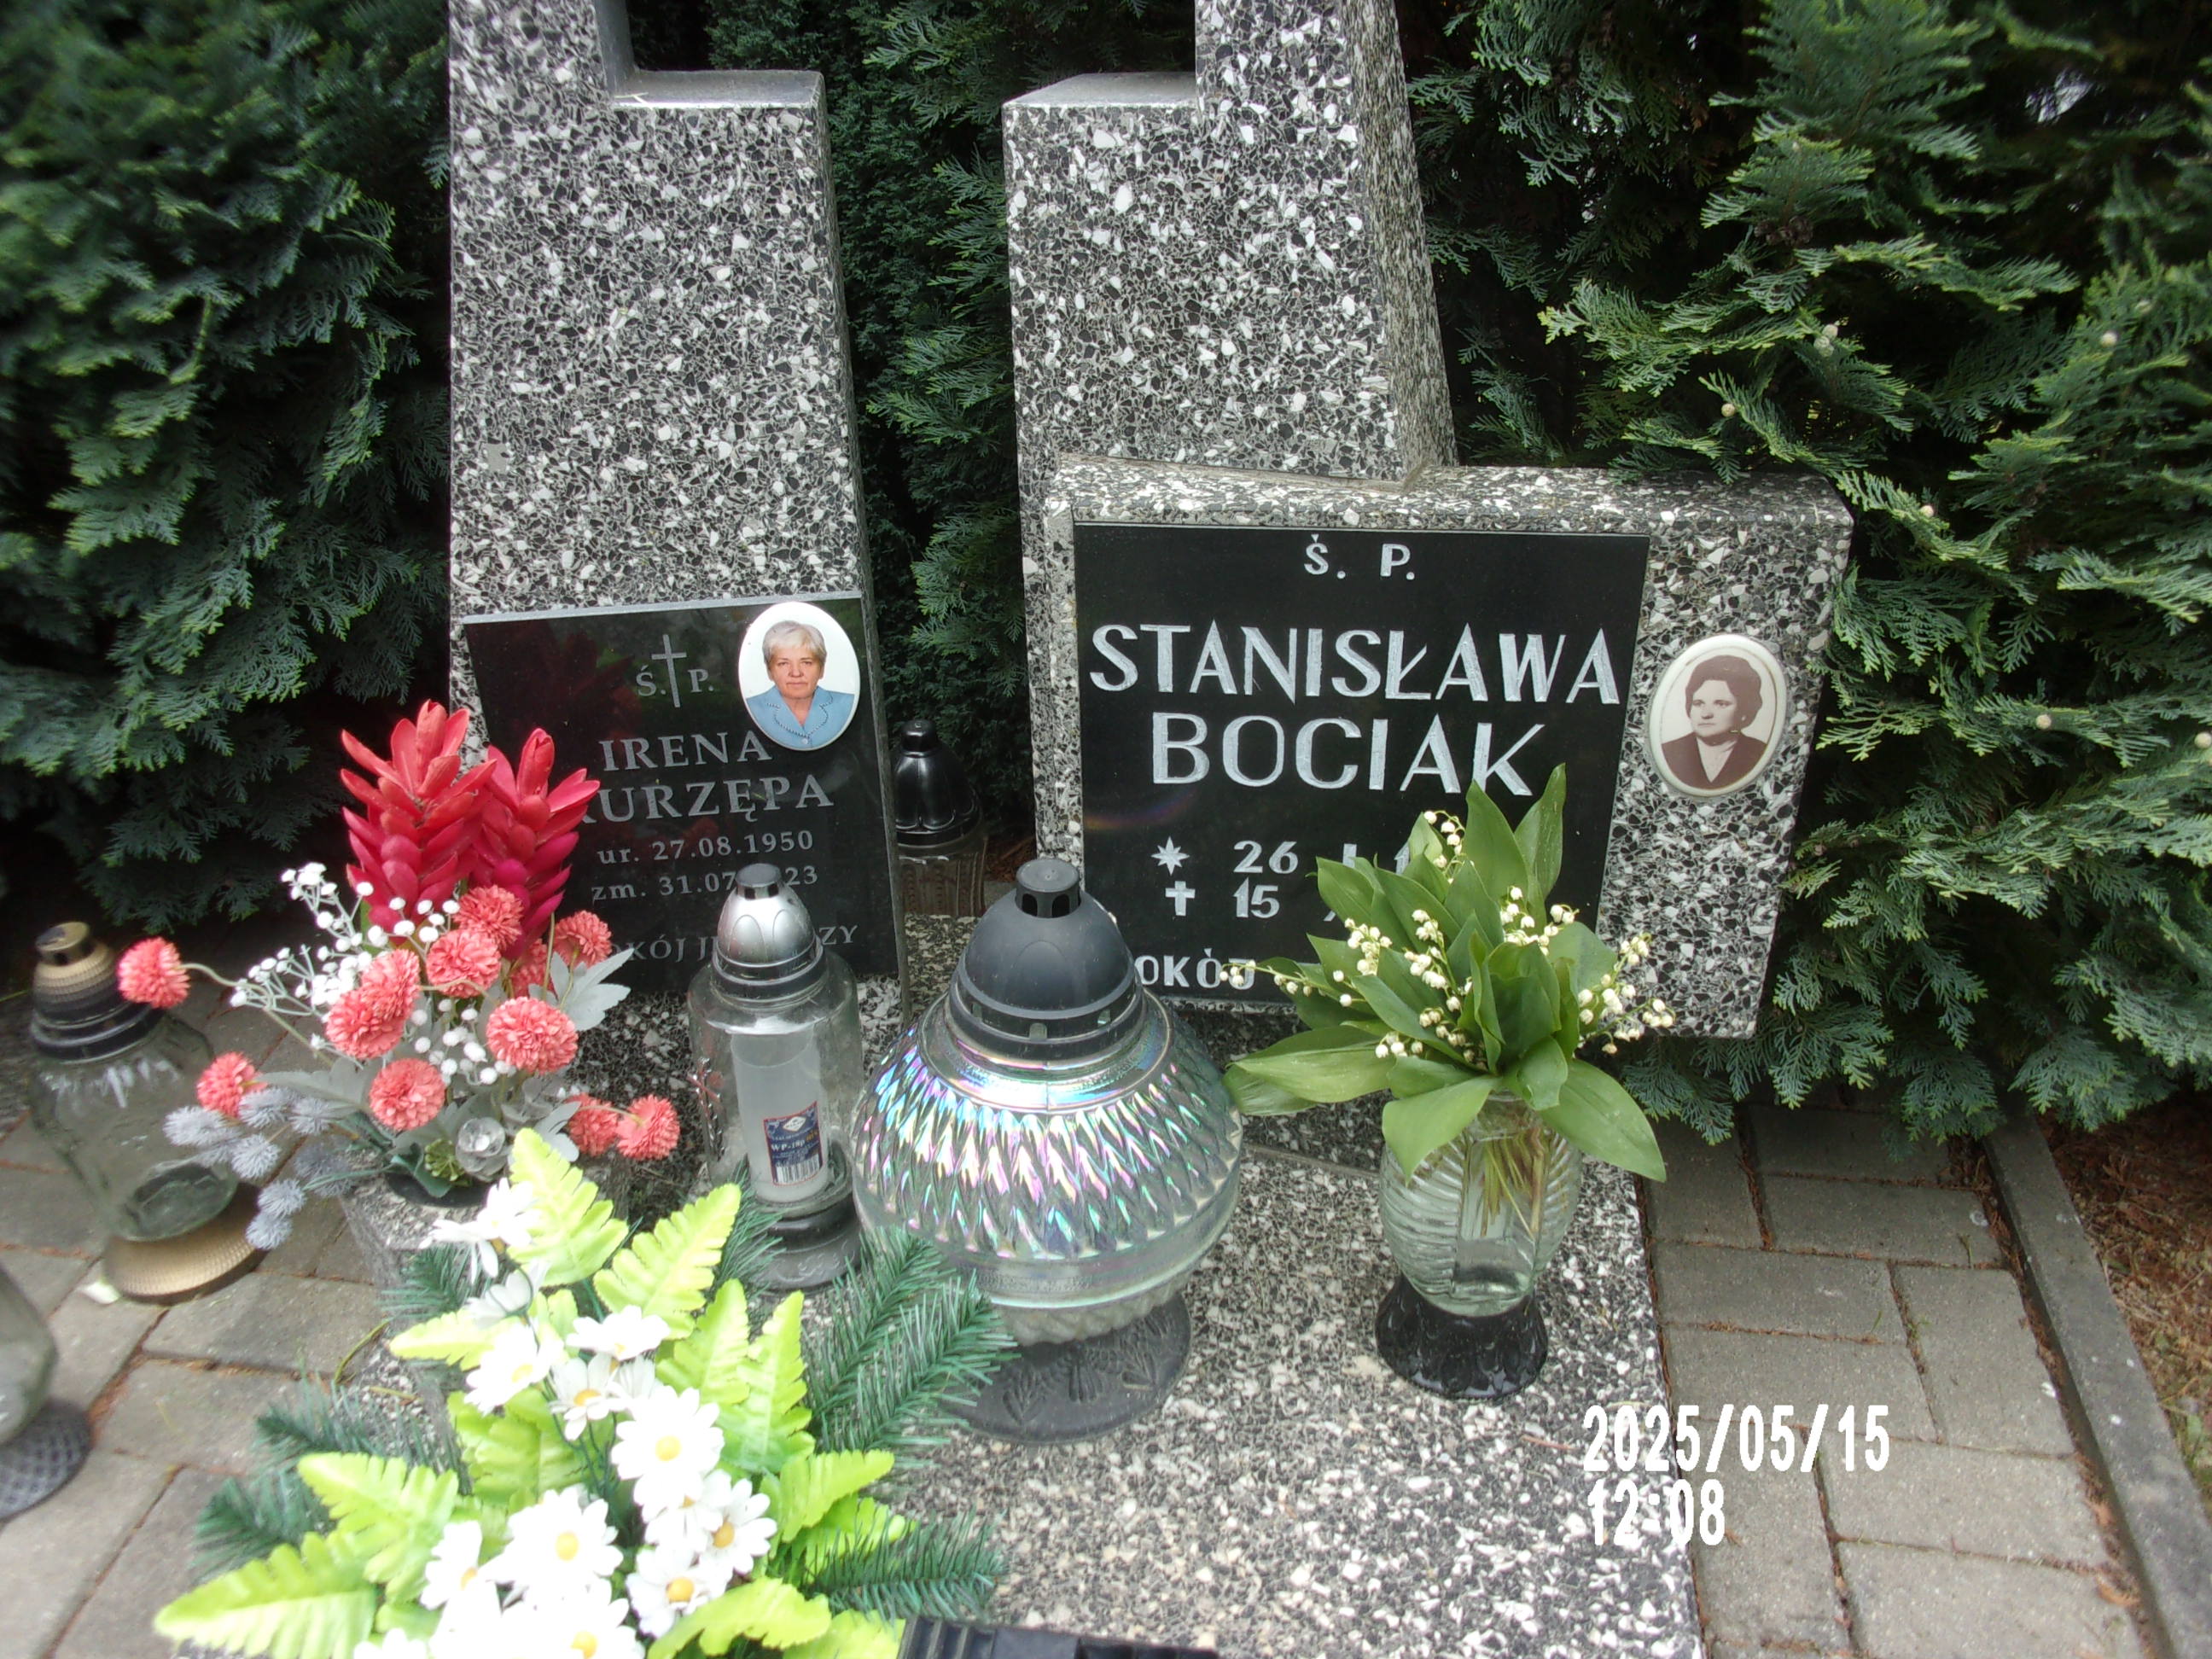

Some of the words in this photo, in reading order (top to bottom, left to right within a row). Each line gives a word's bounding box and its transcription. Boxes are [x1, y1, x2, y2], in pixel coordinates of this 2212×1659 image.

[1379, 543, 1416, 581] P.
[636, 664, 667, 696] Ś.
[687, 668, 714, 694] P.
[1089, 619, 1620, 705] STANISŁAWA
[598, 730, 772, 771] IRENA
[1152, 712, 1545, 796] BOCIAK
[582, 773, 835, 824] URZĘPA
[597, 847, 640, 865] ur.
[651, 830, 813, 861] 27.08.1950
[1233, 840, 1299, 875] 26
[591, 883, 647, 901] zm.
[658, 864, 818, 896] 31.0723
[1233, 876, 1281, 919] 15
[1134, 947, 1256, 991] OKÓJ
